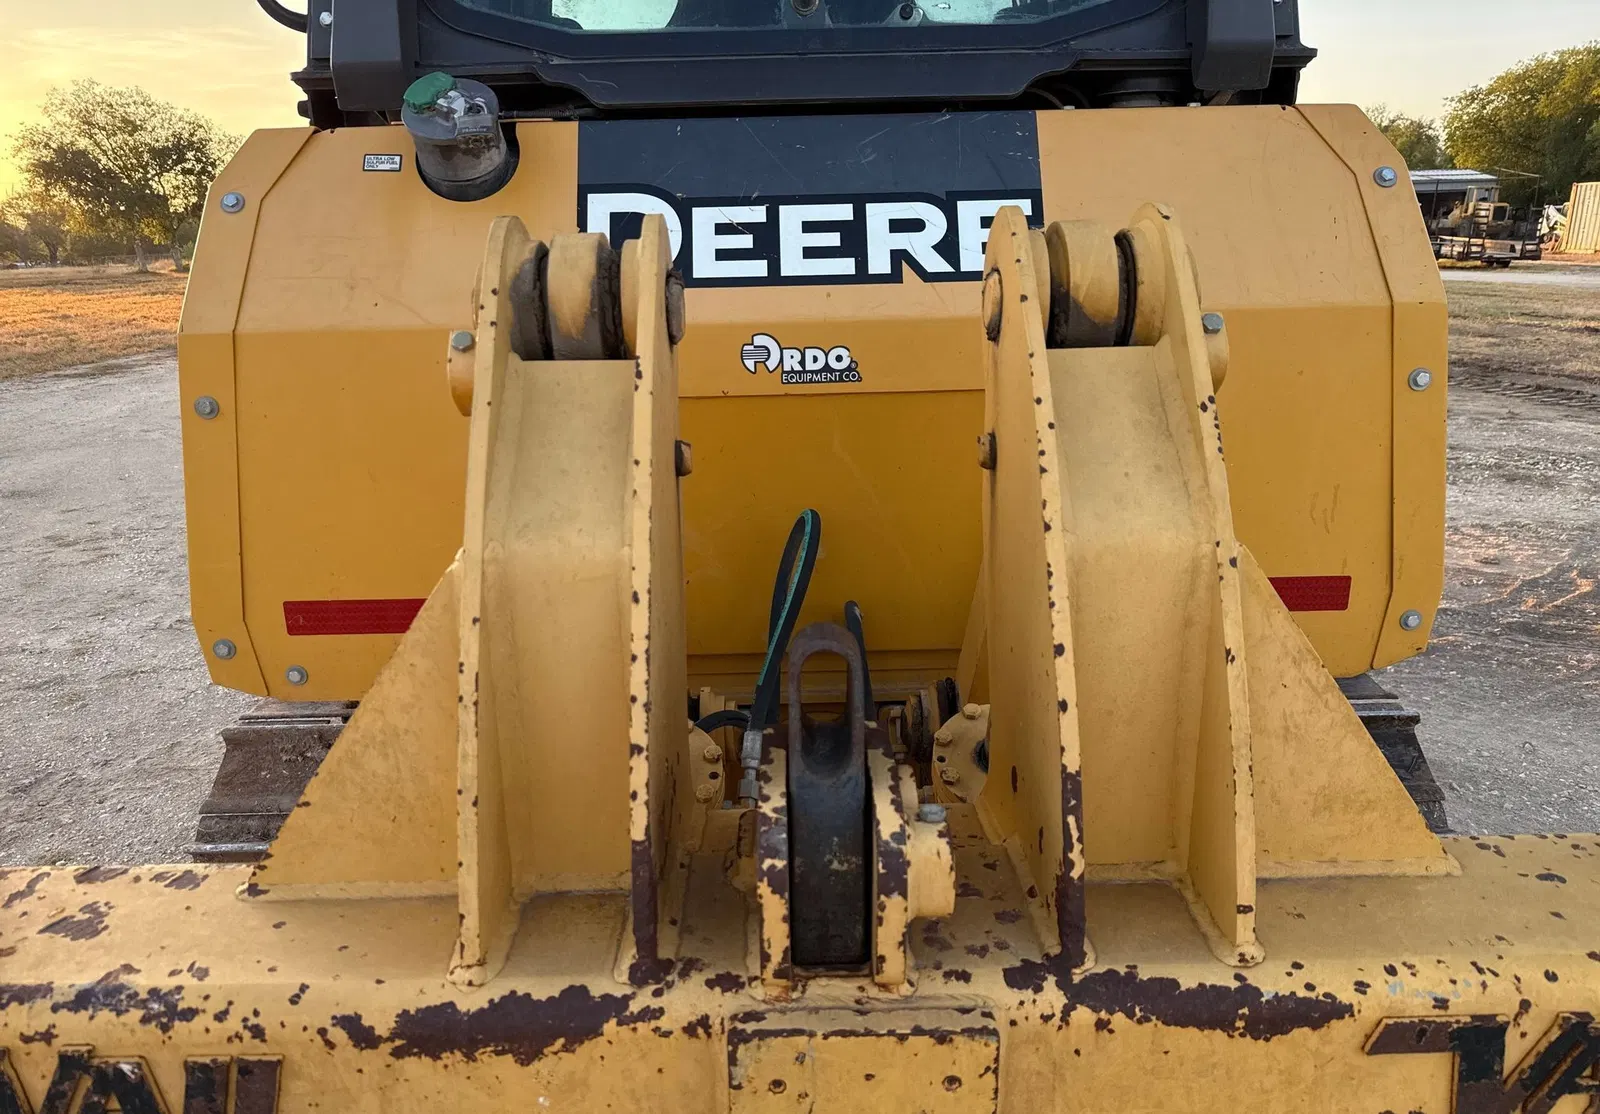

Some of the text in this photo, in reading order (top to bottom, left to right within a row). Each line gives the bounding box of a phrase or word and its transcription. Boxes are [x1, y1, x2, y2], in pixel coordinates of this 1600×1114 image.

[586, 192, 1032, 279] DEERE
[782, 371, 861, 383] EQUIPMENT CO.
